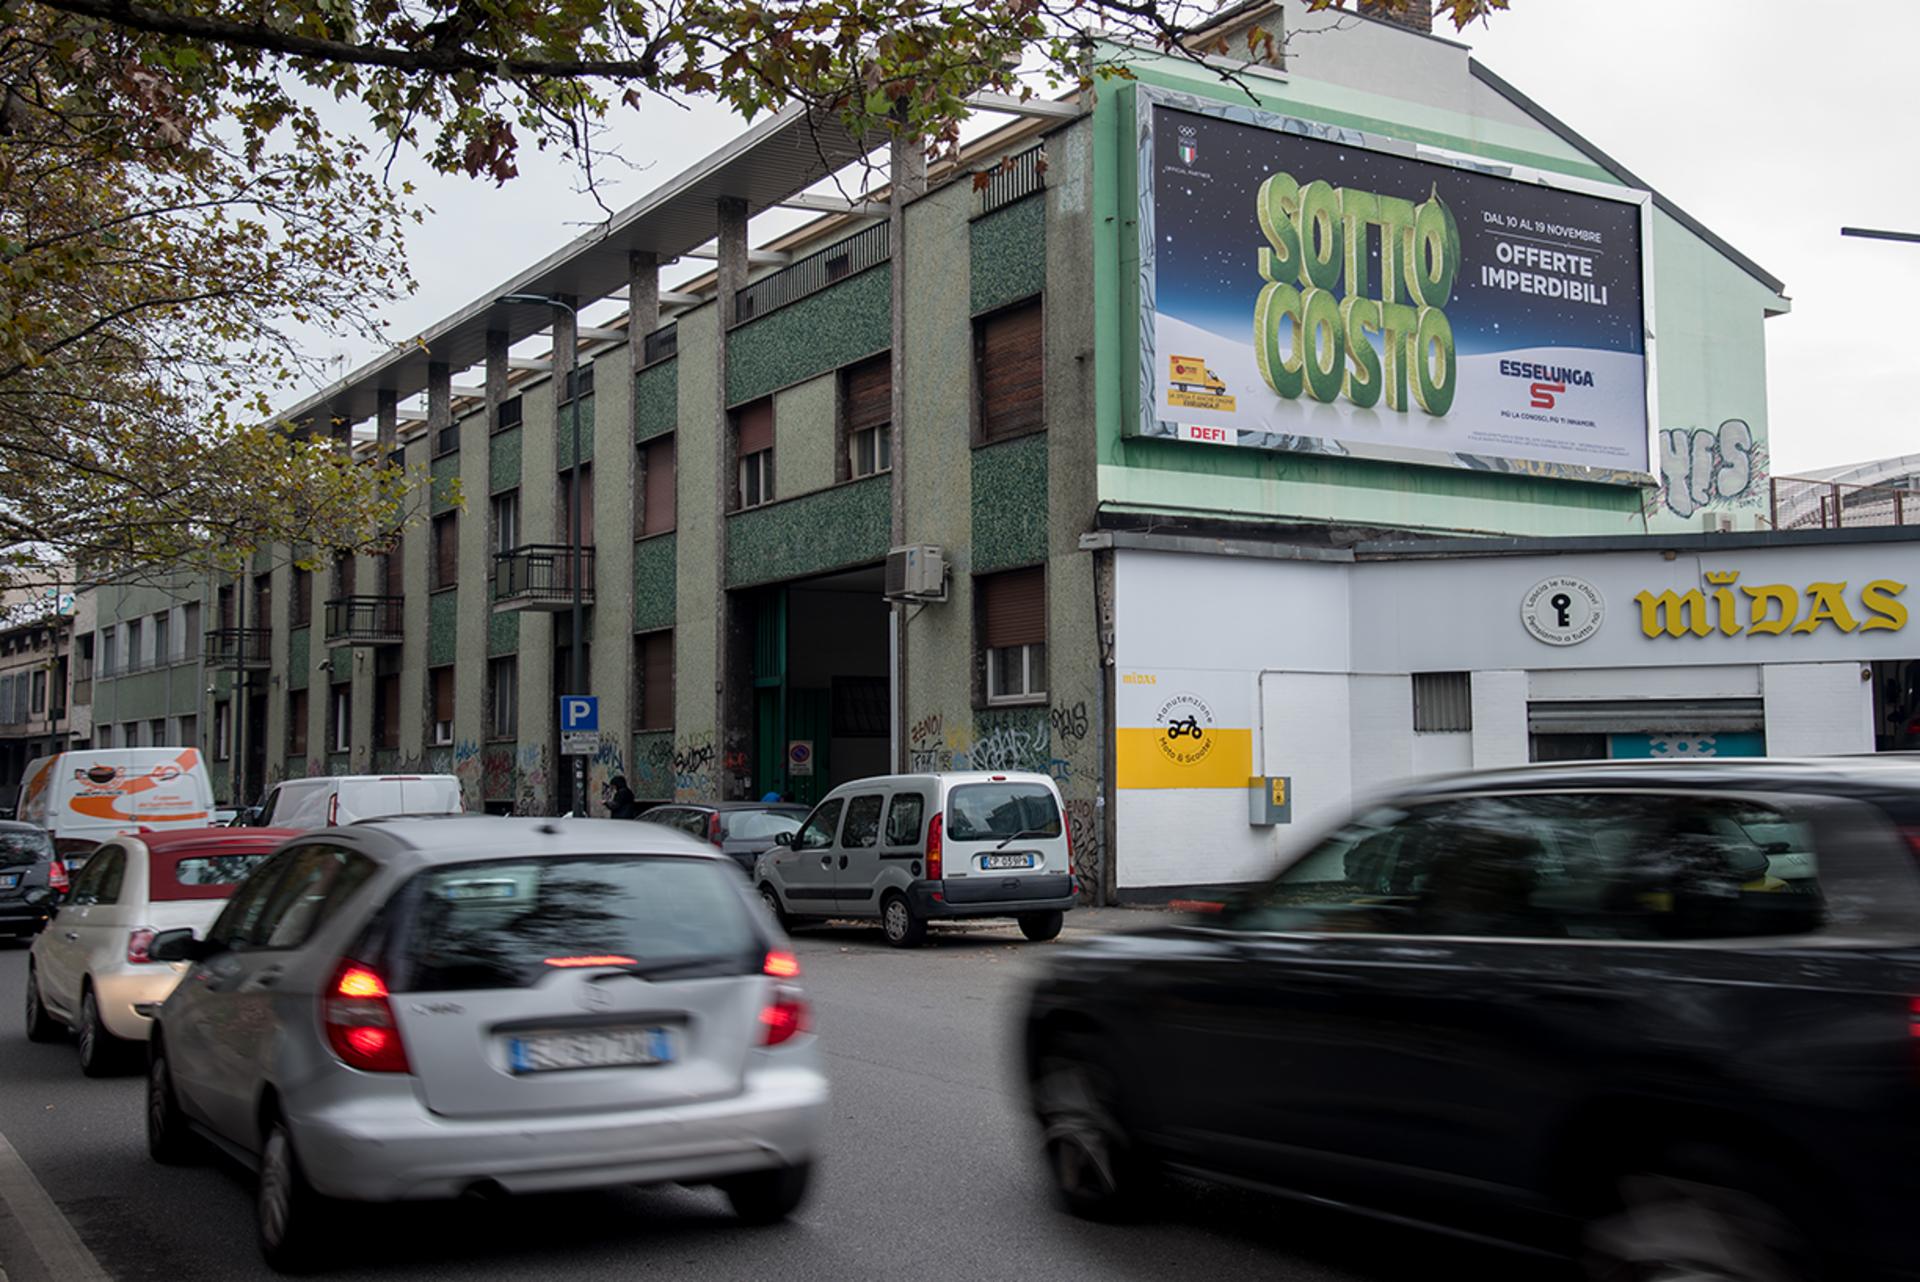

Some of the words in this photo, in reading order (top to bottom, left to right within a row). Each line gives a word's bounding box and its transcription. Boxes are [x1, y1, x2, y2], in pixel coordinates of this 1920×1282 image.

[1257, 172, 1454, 309] SOTTO
[1484, 211, 1504, 225] DAL
[1506, 216, 1518, 228] 10
[1520, 219, 1533, 231] AL
[1535, 222, 1546, 233] 19
[1547, 224, 1602, 244] NOVEMBRE
[1495, 241, 1593, 277] OFFERTE
[1482, 265, 1608, 306] IMPERDIBILI
[1254, 281, 1457, 417] COSTO
[1500, 359, 1594, 387] ESSELUNGA
[1191, 426, 1225, 441] DEFI
[1526, 584, 1548, 607] Lascia
[1578, 584, 1599, 604] chiavi
[1528, 615, 1562, 641] Pensiamo
[1573, 625, 1593, 640] tutto
[570, 701, 590, 726] P
[1156, 696, 1212, 723] Manutenzione
[1160, 737, 1175, 758] Moto
[1177, 753, 1183, 762] &
[1185, 738, 1212, 763] Scooter
